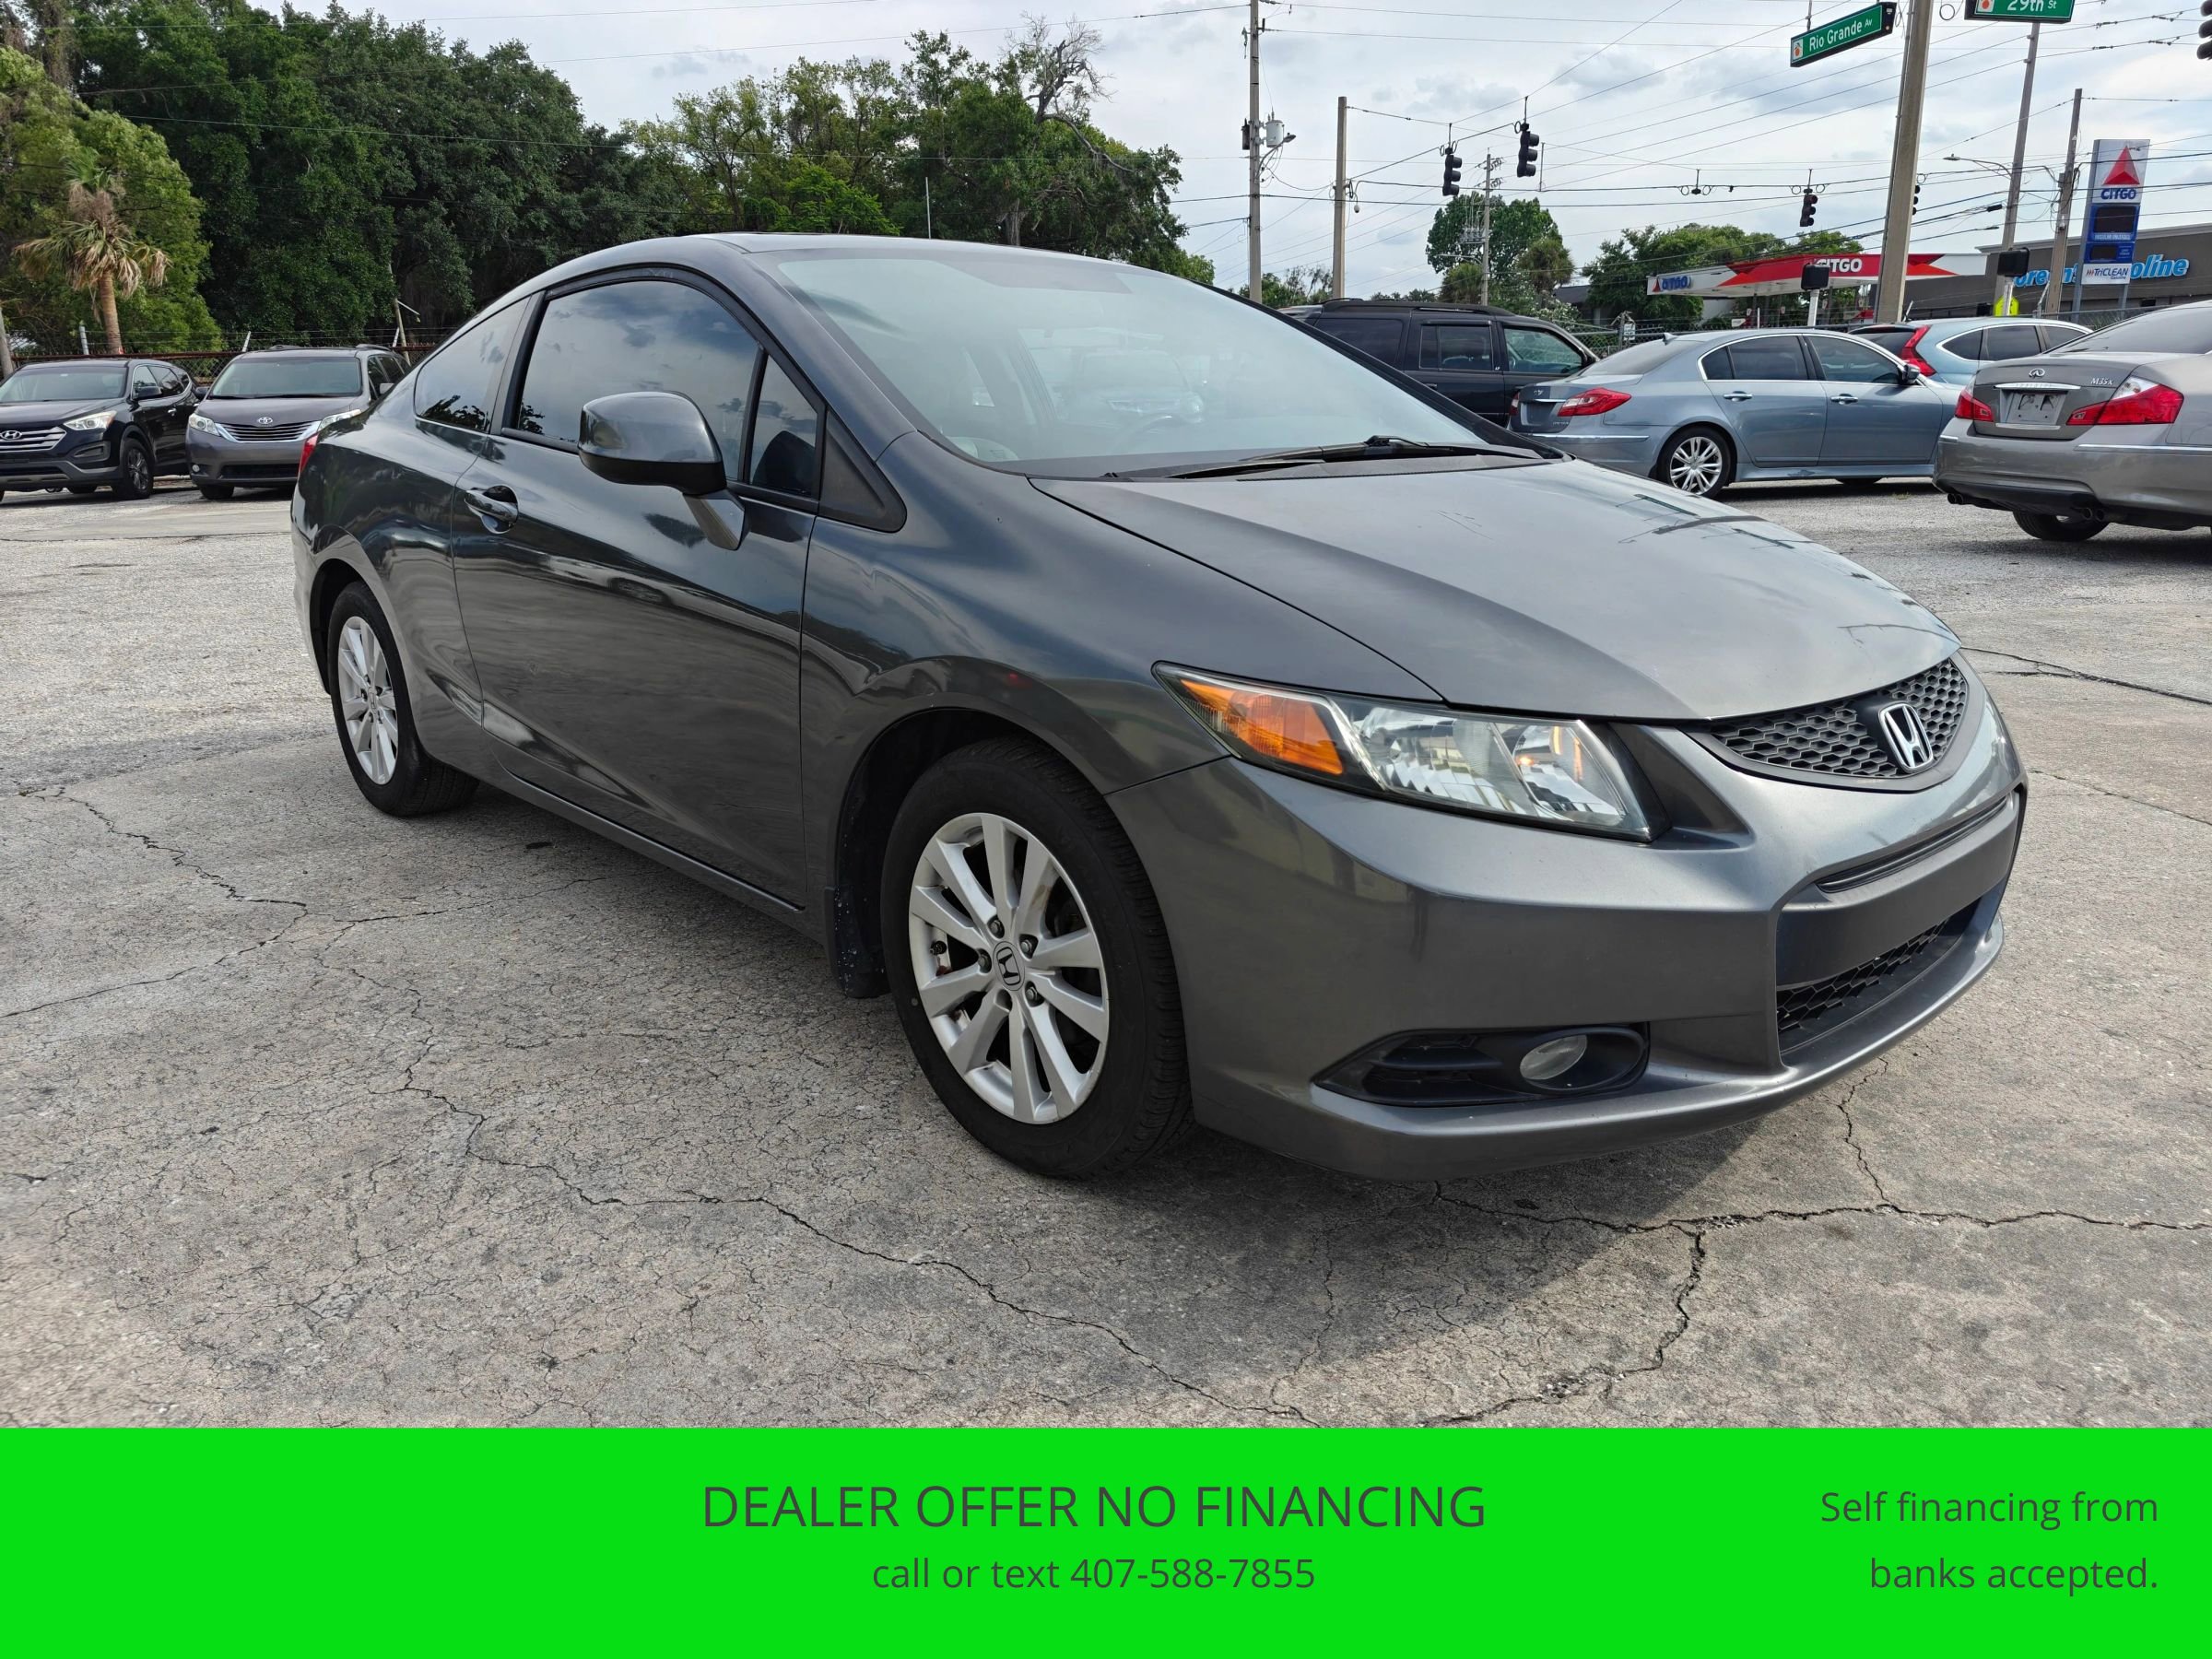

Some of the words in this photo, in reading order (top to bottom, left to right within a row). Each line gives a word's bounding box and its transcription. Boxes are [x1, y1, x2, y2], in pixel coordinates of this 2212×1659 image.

[2006, 0, 2044, 12] 29th
[2047, 0, 2057, 9] St
[1809, 35, 1825, 52] Rio
[1827, 20, 1863, 44] Grande
[1865, 18, 1873, 28] Av
[2100, 188, 2137, 200] CITGO
[2094, 267, 2129, 276] TriCLEAN
[2130, 253, 2190, 279] oline
